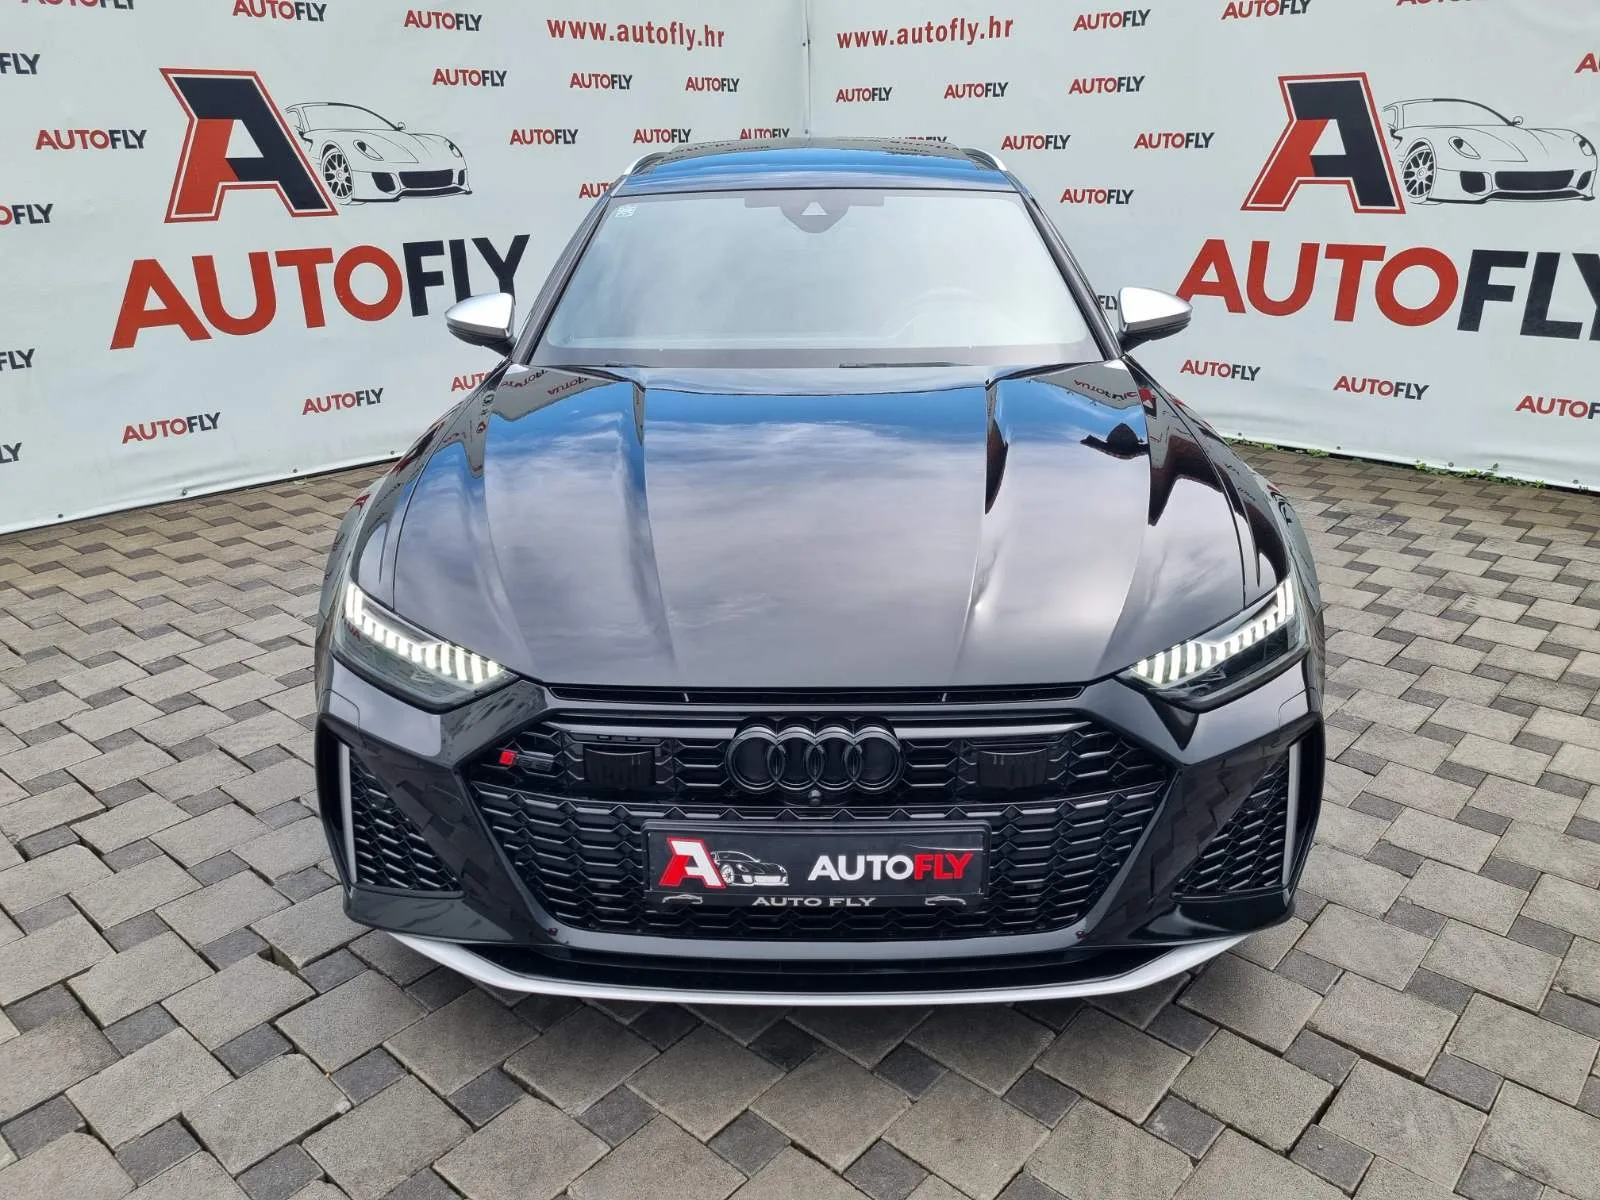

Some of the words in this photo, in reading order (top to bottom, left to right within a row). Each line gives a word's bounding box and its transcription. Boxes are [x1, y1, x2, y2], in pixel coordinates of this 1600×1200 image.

[233, 0, 327, 22] AUTOFLY
[1222, 0, 1310, 20] AUTOFLY
[404, 10, 482, 32] AUTOFLY
[1073, 9, 1151, 32] AUTOFLY
[547, 19, 725, 51] www.autofly.hr
[837, 15, 1014, 48] www.autofly.hr
[433, 68, 507, 87] AUTOFLY
[570, 73, 633, 90] AUTOFLY
[686, 76, 740, 93] AUTOFLY
[1069, 76, 1145, 95] AUTOFLY
[836, 87, 892, 103] AUTOFLY
[944, 82, 1008, 99] AUTOFLY
[36, 129, 147, 150] AUTOFLY
[510, 129, 579, 146] AUTOFLY
[633, 129, 692, 144] AUTOFLY
[1001, 135, 1071, 151] AUTOFLY
[1133, 132, 1214, 150] AUTOFLY
[1060, 189, 1134, 205] AUTOFLY
[110, 234, 530, 350] AUTOFLY
[1180, 359, 1260, 382] AUTOFLY
[1333, 376, 1429, 400] AUTOFLY
[302, 388, 384, 415] AUTOFLY
[122, 412, 221, 444] AUTOFLY
[808, 852, 974, 881] AUTOFLY
[752, 896, 822, 907] AUTO
[828, 896, 877, 907] FLY
